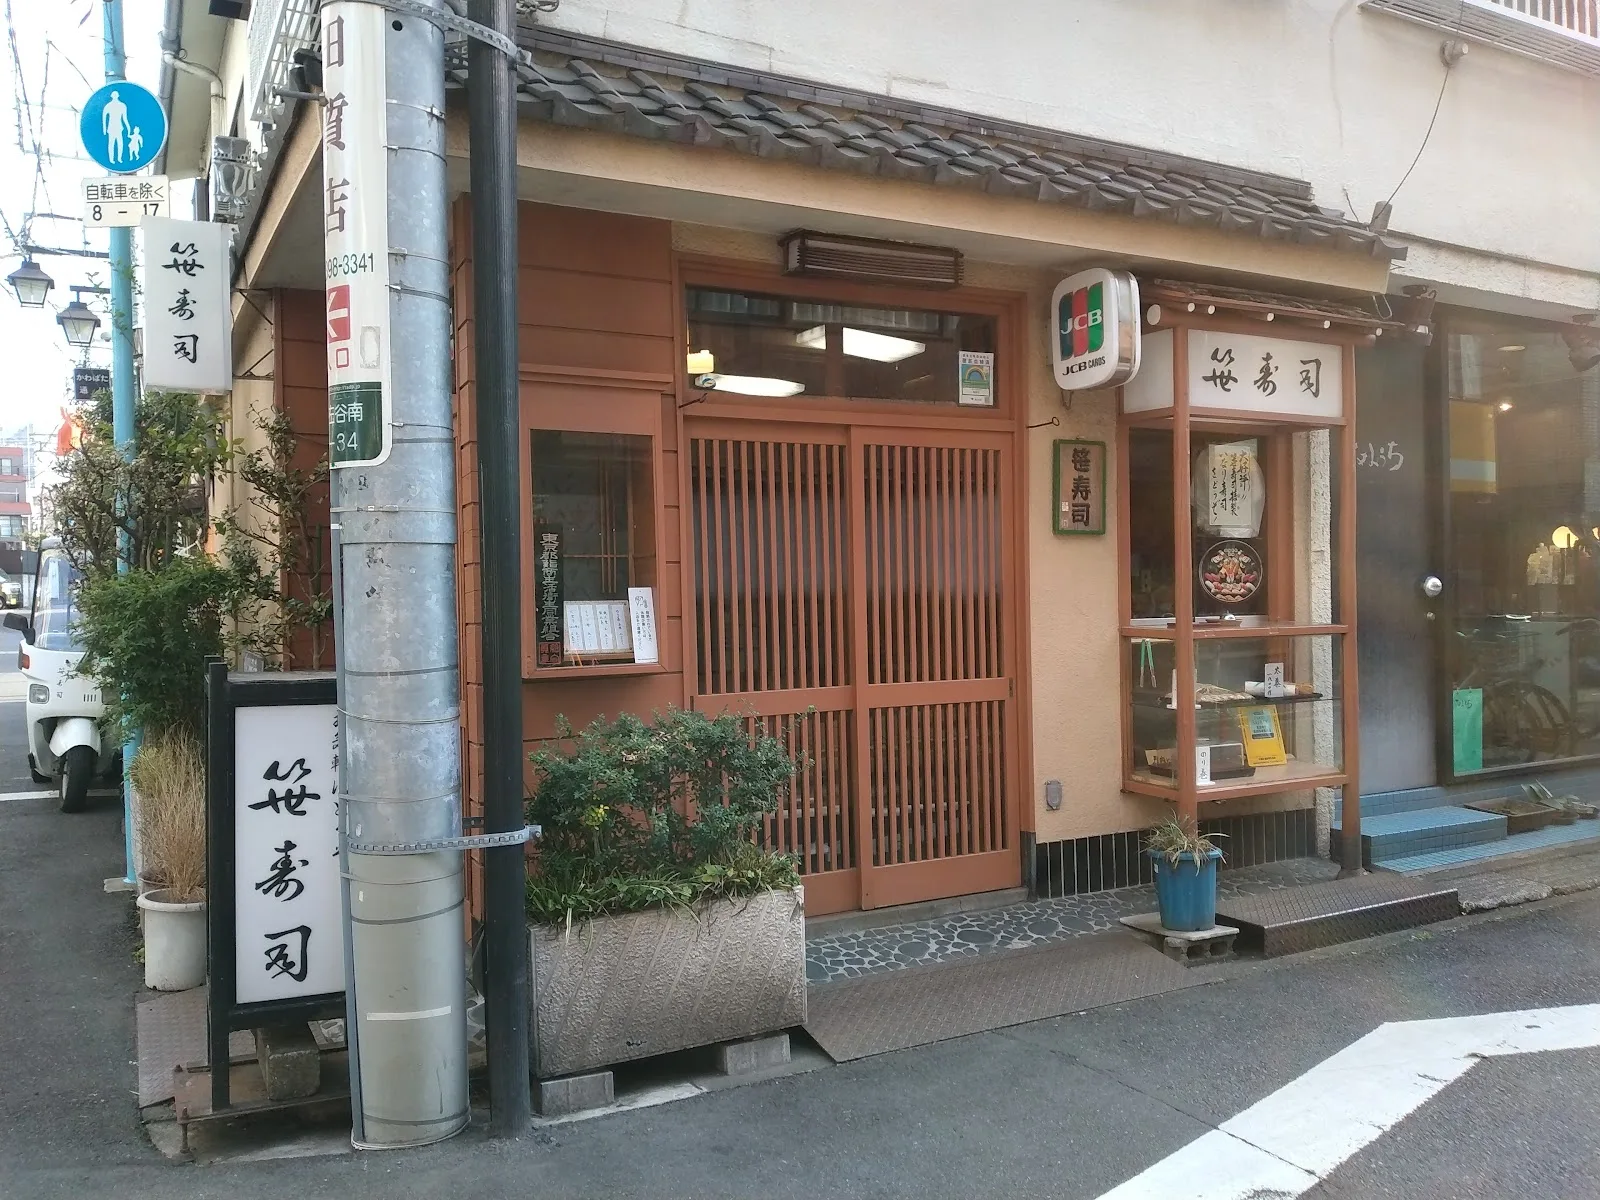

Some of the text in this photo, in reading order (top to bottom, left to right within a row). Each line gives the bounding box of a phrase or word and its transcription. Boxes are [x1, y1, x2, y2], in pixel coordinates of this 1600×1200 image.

[86, 183, 164, 200] 自転車を除く
[92, 205, 103, 221] 8
[143, 203, 159, 217] 17
[161, 242, 204, 363] 笹寿司
[1060, 308, 1103, 335] JCB
[76, 374, 109, 383] かわばた
[1062, 356, 1106, 376] JCB CARDS
[1202, 347, 1322, 398] 笹寿司
[1071, 447, 1092, 527] 笹寿司
[1200, 751, 1208, 780] のり巻
[248, 757, 321, 983] 笹寿司
